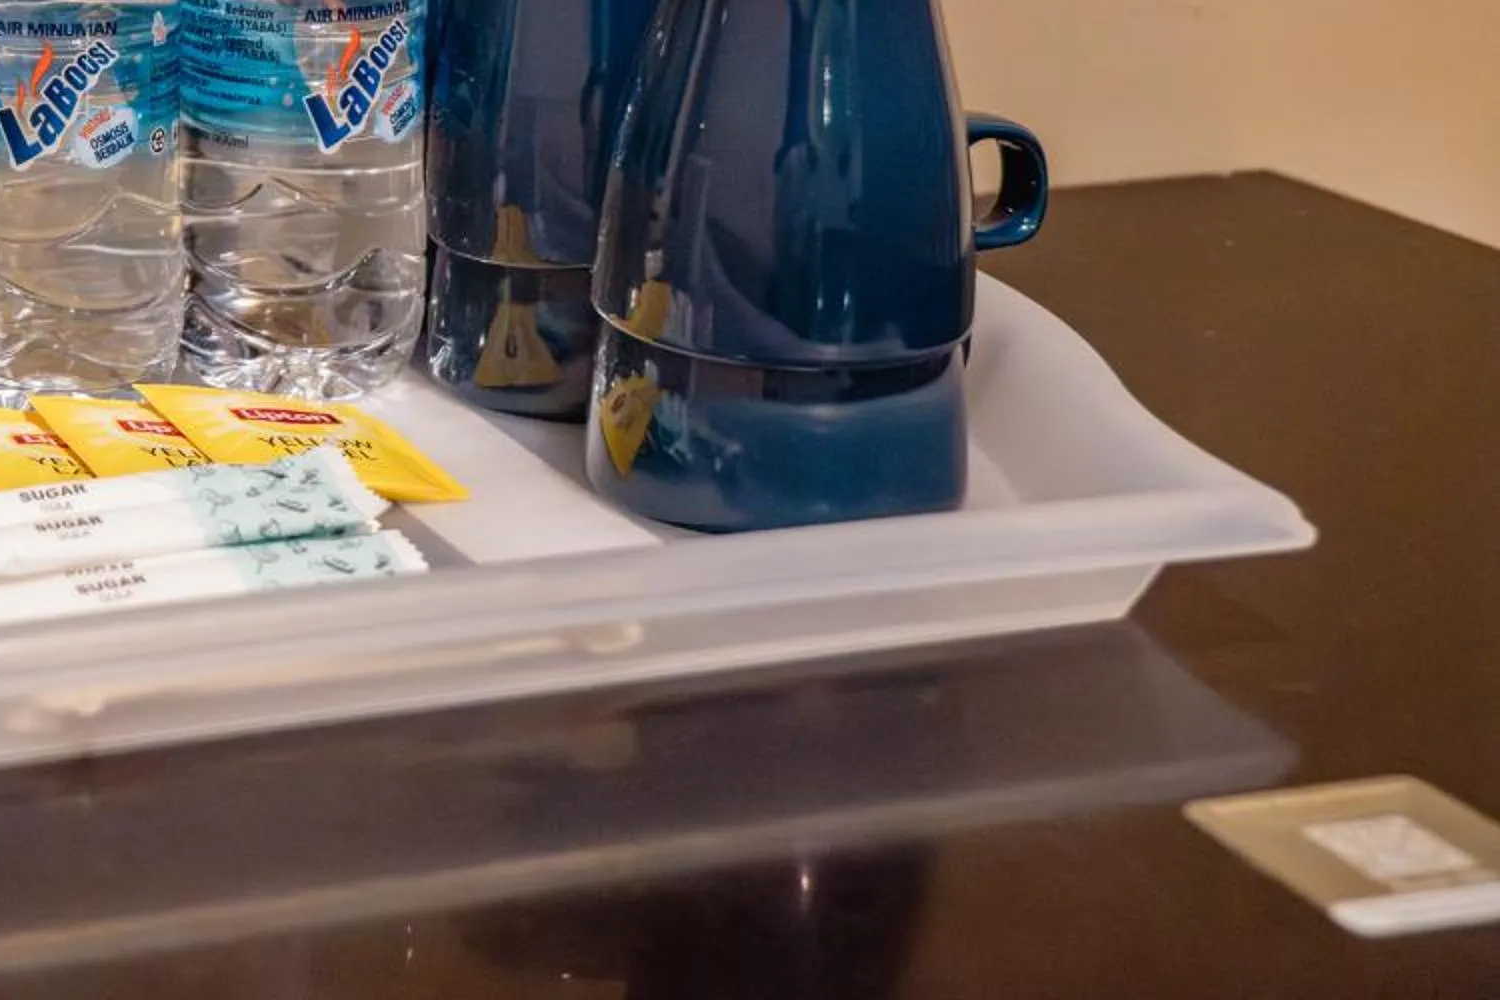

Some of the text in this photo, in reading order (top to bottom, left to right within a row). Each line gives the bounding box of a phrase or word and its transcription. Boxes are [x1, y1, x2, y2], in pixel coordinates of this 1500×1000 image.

[304, 8, 333, 23] AIR
[27, 21, 118, 37] MINUMAN
[237, 407, 333, 424] Lipton
[19, 484, 87, 502] SUGAR
[35, 515, 103, 532] SUGAR
[76, 574, 146, 594] SUGAR
